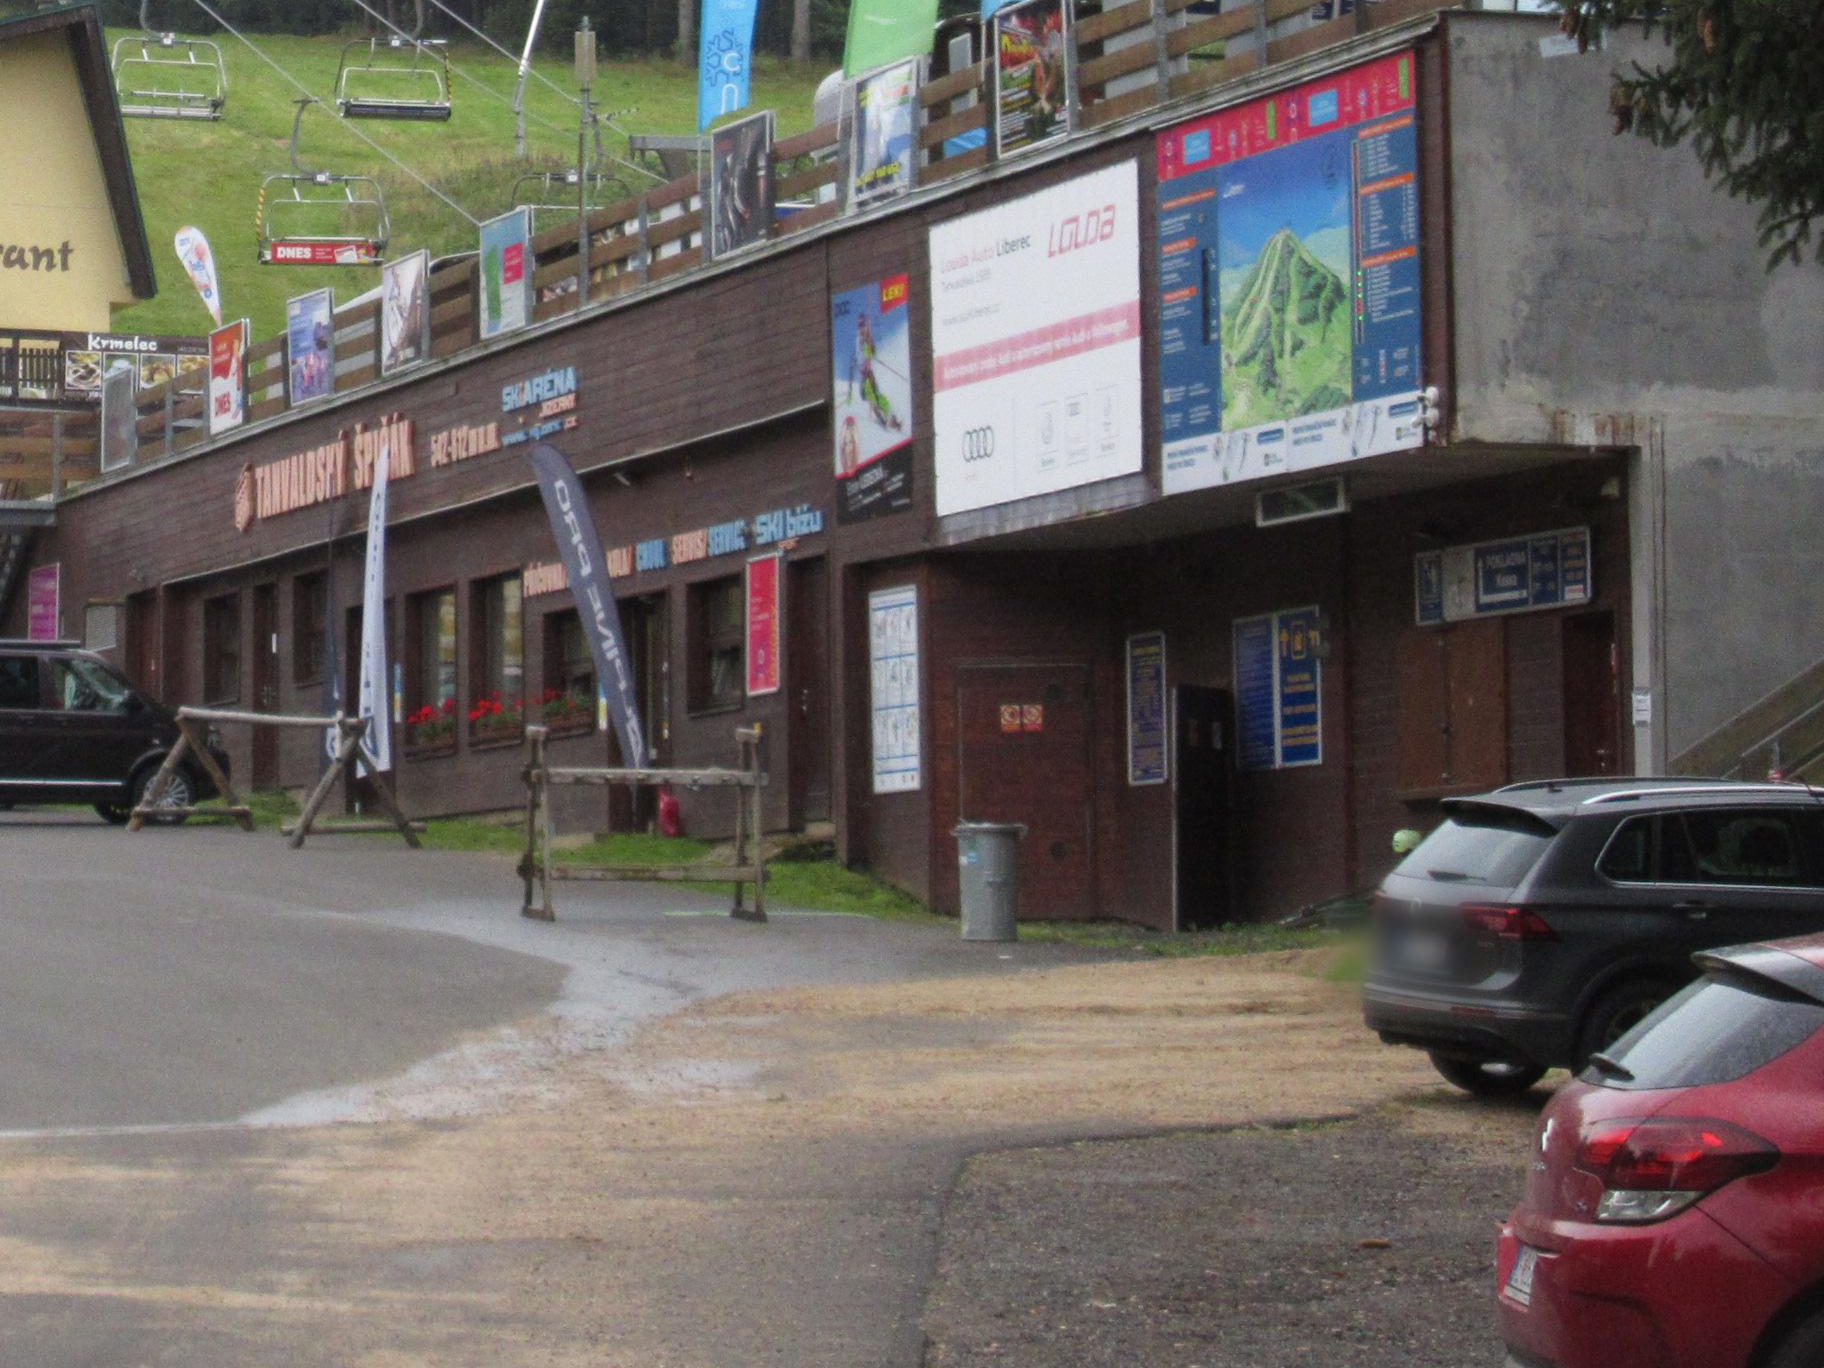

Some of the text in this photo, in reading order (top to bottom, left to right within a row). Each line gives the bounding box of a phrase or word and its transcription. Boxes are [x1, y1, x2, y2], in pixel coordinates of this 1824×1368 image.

[276, 246, 312, 259] DNES
[996, 234, 1032, 258] Liberec
[87, 334, 158, 352] Krmelec
[255, 429, 348, 520] TANVALDSKÝ
[755, 509, 783, 546] SKI
